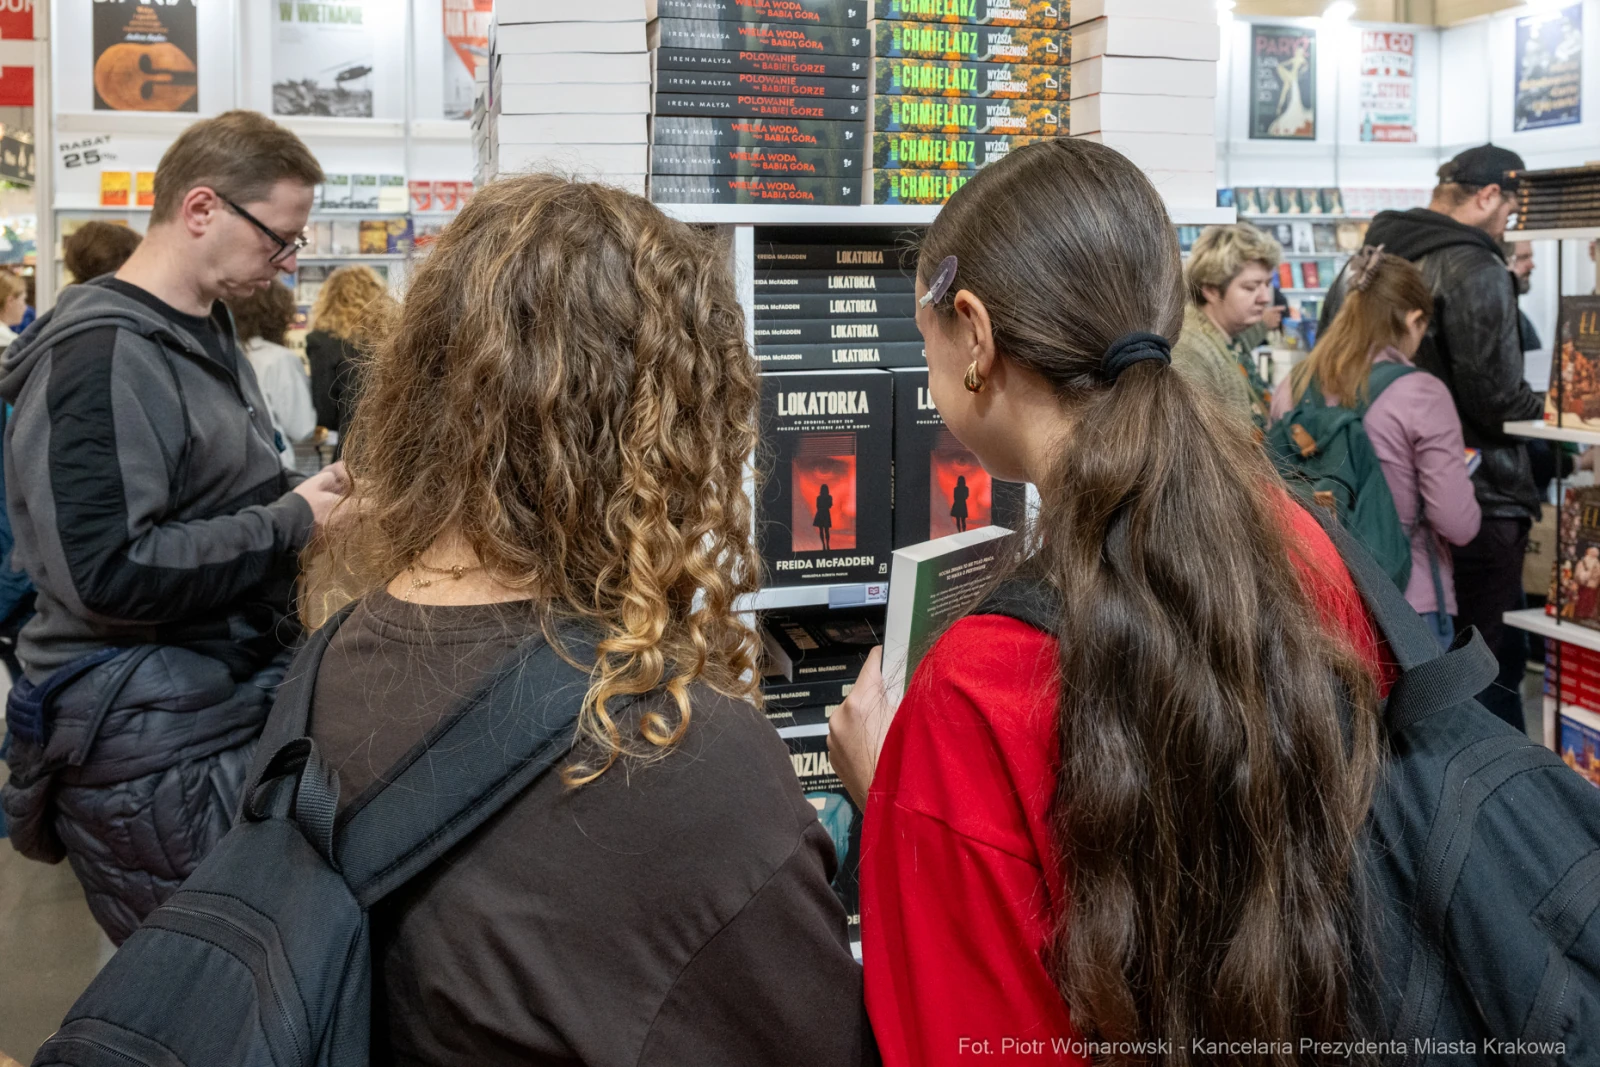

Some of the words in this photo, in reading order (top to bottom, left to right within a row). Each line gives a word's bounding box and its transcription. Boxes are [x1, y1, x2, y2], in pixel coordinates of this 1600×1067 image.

[735, 0, 770, 9] WIELKA
[773, 1, 802, 10] WODA
[901, 0, 976, 17] CHMIELARZ
[768, 9, 793, 20] BABIĄ
[796, 9, 820, 21] GÓRĄ
[668, 31, 695, 39] IRENA
[738, 28, 774, 38] WIELKA
[777, 30, 805, 39] WODA
[988, 33, 1012, 44] WYŻSZA
[771, 38, 797, 49] BABIĄ
[799, 39, 823, 50] GÓRĄ
[903, 28, 978, 54] CHMIELARZ
[740, 52, 796, 63] POLOWANIE
[762, 62, 790, 72] BABIEJ
[792, 63, 825, 73] GÓRZE
[740, 74, 796, 85] POLOWANIE
[902, 65, 977, 90] CHMIELARZ
[987, 69, 1011, 80] WYŻSZA
[701, 79, 732, 87] MAŁYSA
[762, 84, 790, 94] BABIEJ
[792, 85, 825, 95] GÓRZE
[738, 96, 795, 107] POLOWANIE
[761, 106, 788, 116] BABIEJ
[791, 107, 824, 116] GÓRZE
[902, 102, 977, 126] CHMIELARZ
[986, 105, 1010, 116] WYŻSZA
[731, 123, 767, 132] WIELKA
[769, 125, 798, 134] WODA
[764, 134, 790, 143] BABIĄ
[792, 134, 817, 144] GÓRĄ
[901, 139, 975, 163] CHMIELARZ
[985, 141, 1009, 152] WYŻSZA
[729, 152, 765, 161] WIELKA
[768, 153, 797, 162] WODA
[762, 162, 788, 172] BABIĄ
[790, 163, 815, 172] GÓRĄ
[728, 181, 764, 190] WIELKA
[766, 182, 795, 191] WODA
[901, 176, 972, 198] CHMIELA
[761, 191, 787, 200] BABIĄ
[789, 191, 814, 200] GÓRĄ
[837, 251, 884, 264] LOKATORKA
[828, 275, 876, 289] LOKATORKA
[830, 300, 877, 313] LOKATORKA
[831, 324, 879, 338] LOKATORKA
[832, 348, 880, 363] LOKATORKA
[778, 391, 869, 416] LOKATORKA
[776, 559, 813, 571] FREIDA
[816, 556, 874, 568] McFADDEN
[781, 691, 810, 699] McFADDEN
